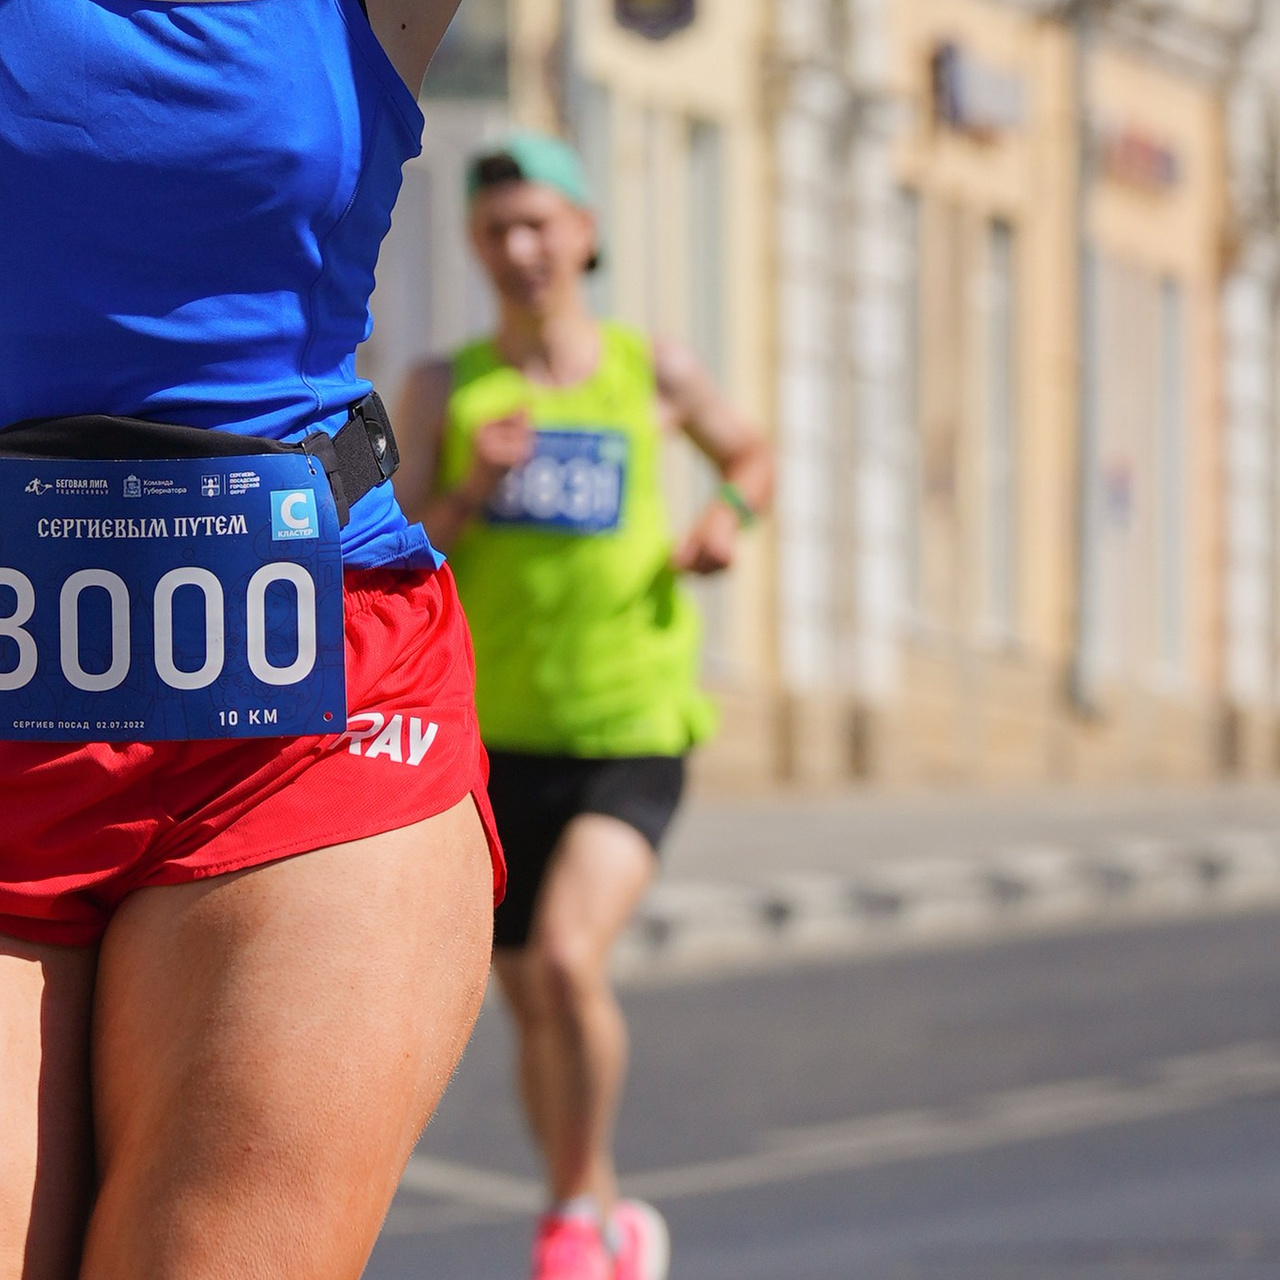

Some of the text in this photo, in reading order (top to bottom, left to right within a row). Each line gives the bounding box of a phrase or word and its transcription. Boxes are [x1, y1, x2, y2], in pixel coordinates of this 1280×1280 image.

[55, 479, 108, 489] БЕГОВАЯ ЛИГА
[37, 514, 248, 538] СЕРГИЕВЫМ ПУТЕМ
[277, 528, 314, 538] КЛАСТЕР
[219, 710, 238, 726] 10
[13, 720, 145, 729] СЕРГИЕВ ПОСАД 02.07.2022
